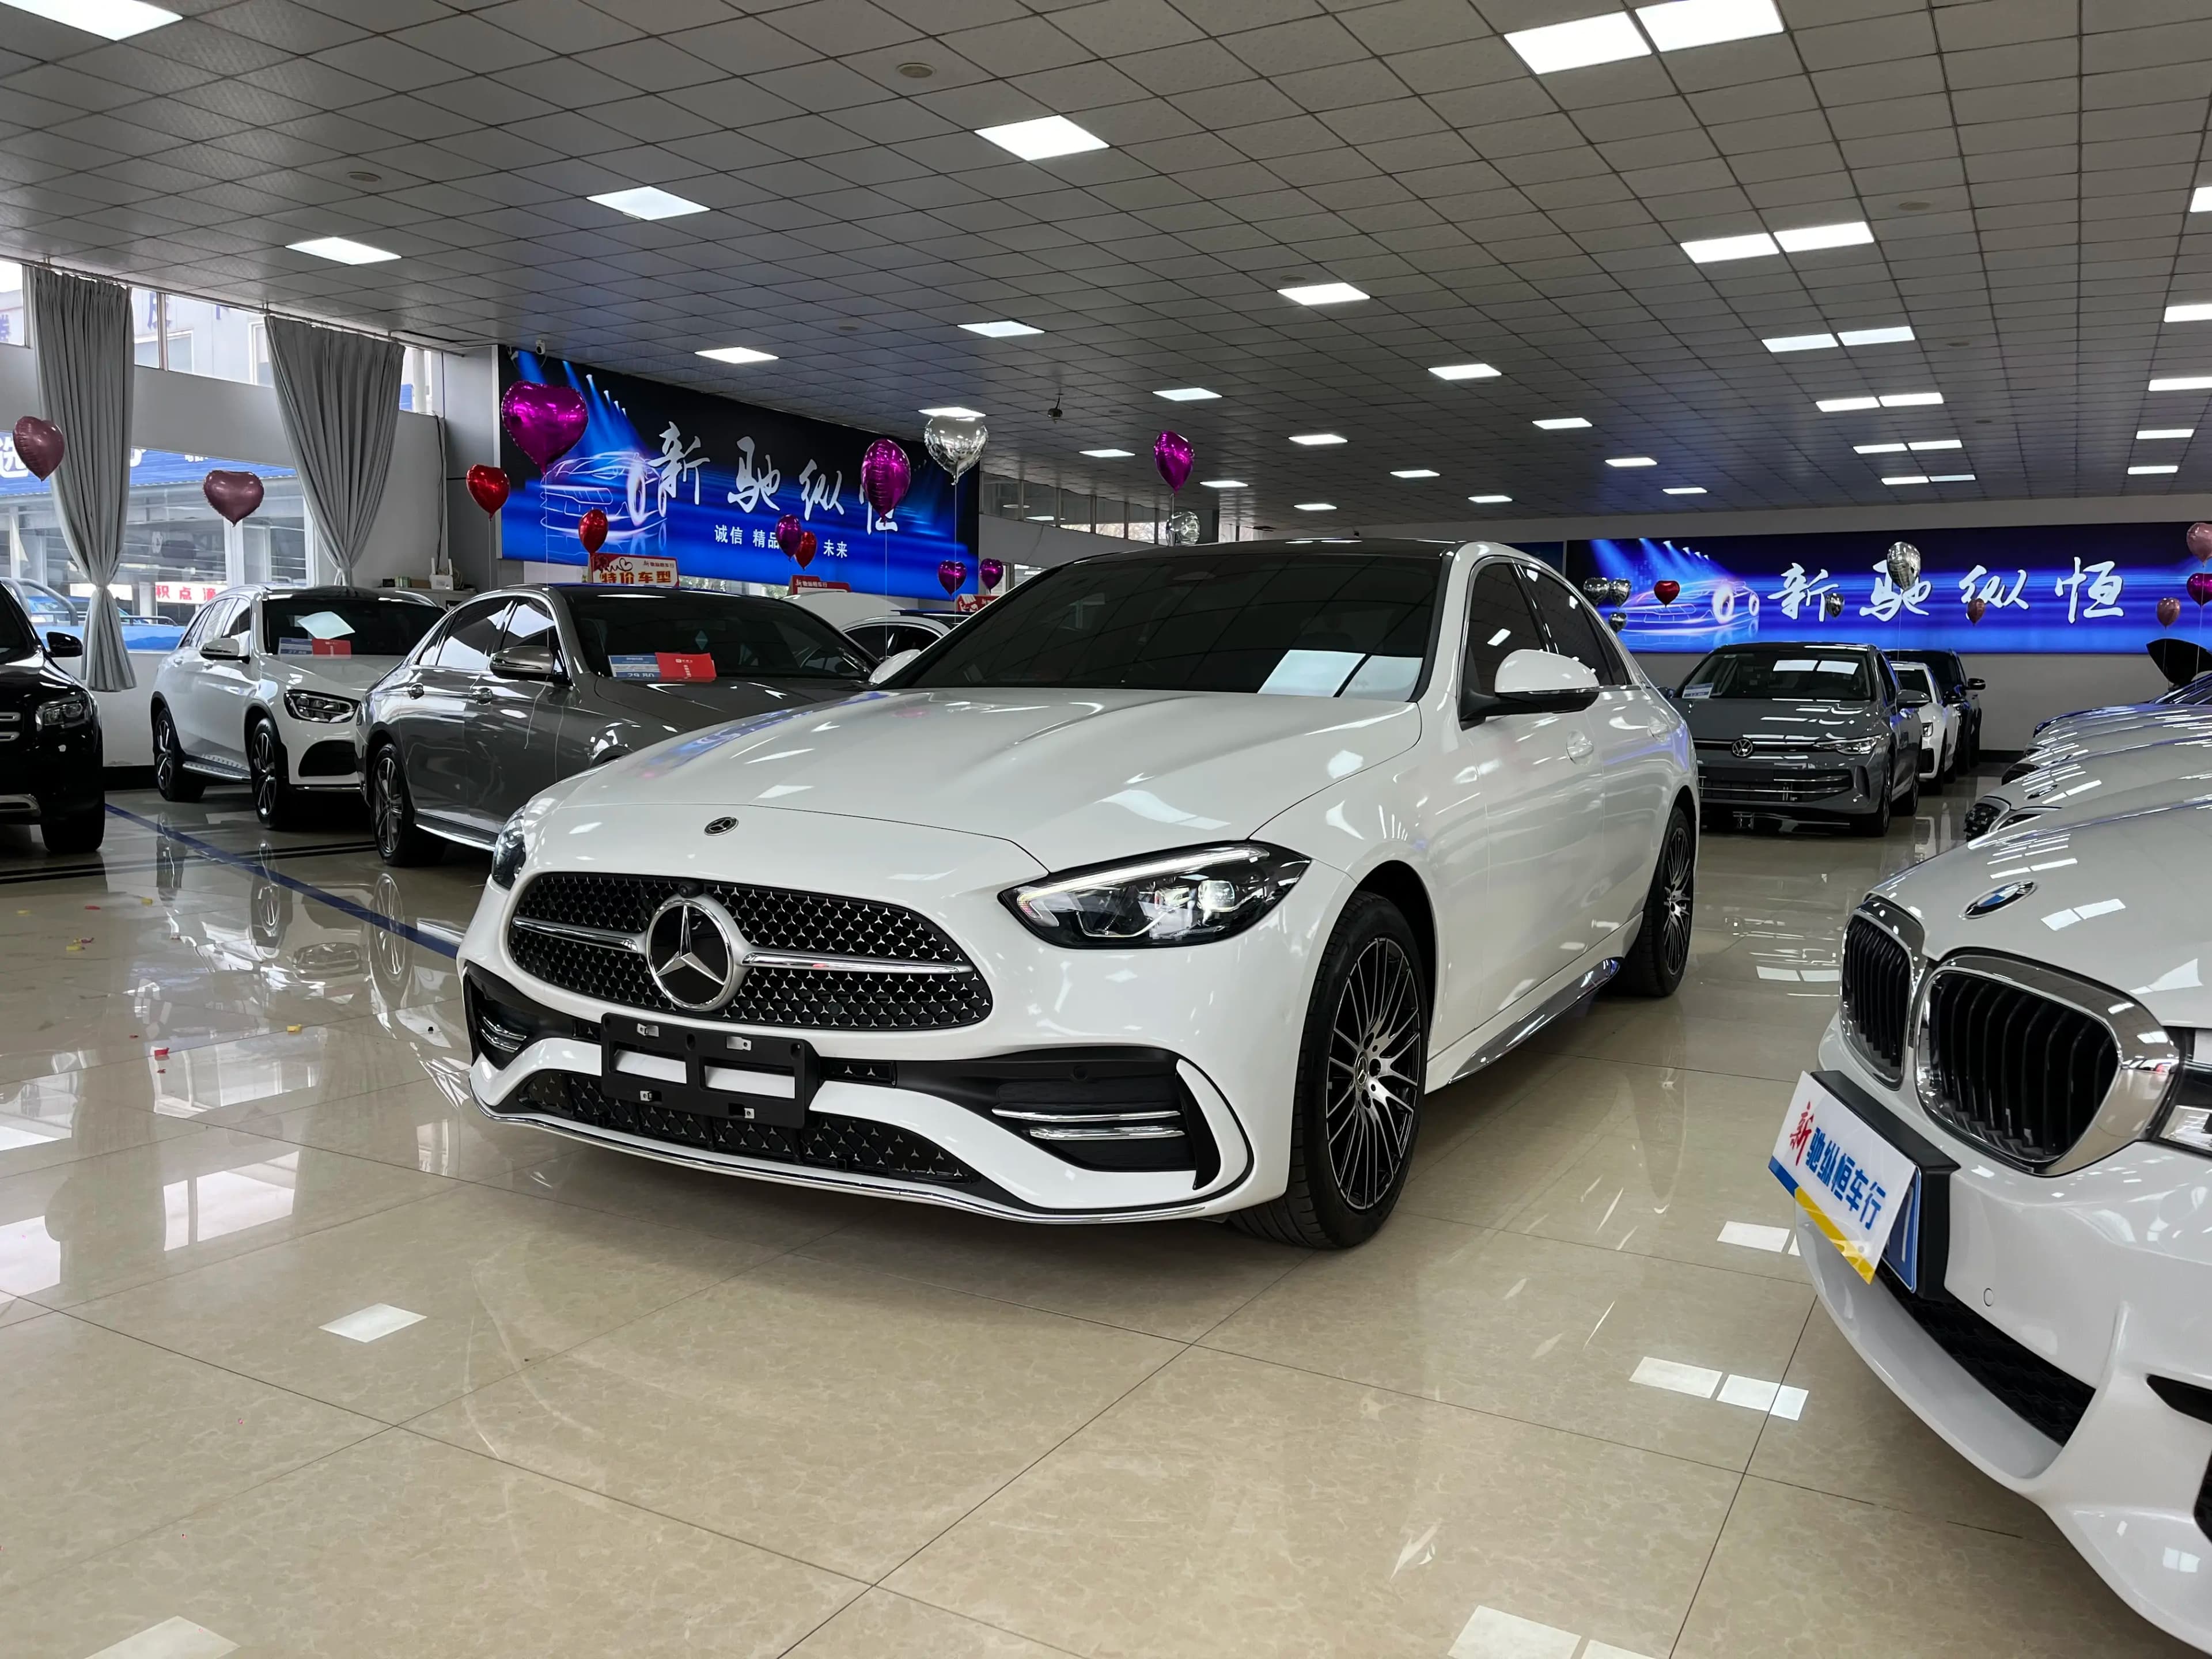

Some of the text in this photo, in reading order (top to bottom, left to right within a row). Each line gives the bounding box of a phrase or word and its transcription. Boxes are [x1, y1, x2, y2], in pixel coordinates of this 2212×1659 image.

[714, 525, 847, 558] 诚信 精品 未来
[600, 571, 671, 584] 特价车型
[1767, 556, 2124, 624] 新驰纵恒
[1790, 1101, 1887, 1230] 新驰纵恒车行
